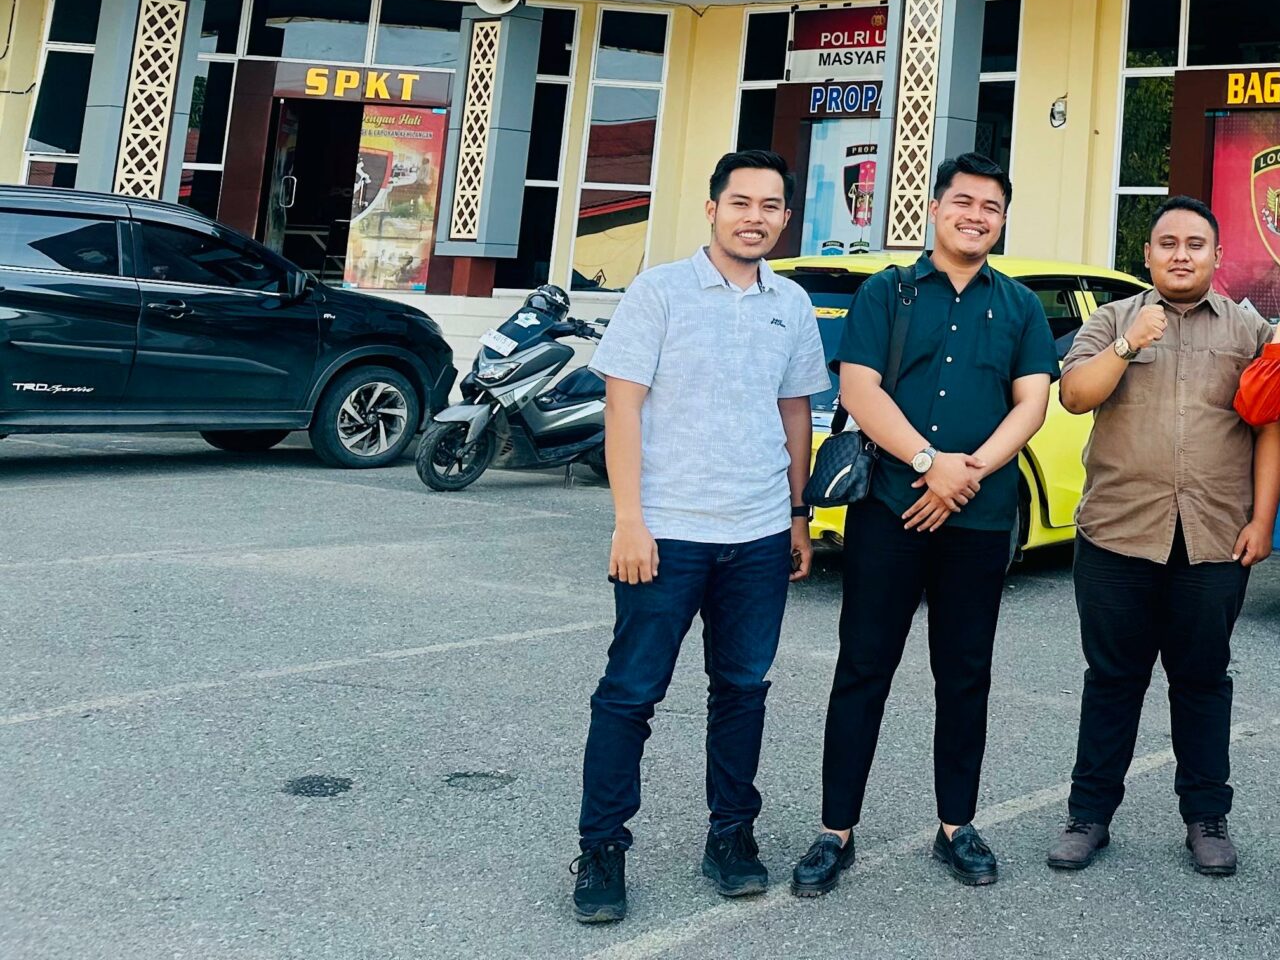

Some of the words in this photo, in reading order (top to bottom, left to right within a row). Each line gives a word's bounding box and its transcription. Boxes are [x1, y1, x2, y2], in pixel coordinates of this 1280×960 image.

[820, 30, 870, 47] POLRI
[818, 50, 885, 66] MASYAR
[305, 67, 420, 101] SPKT
[1227, 71, 1280, 105] BAG
[809, 84, 881, 114] PROP
[851, 144, 877, 154] PROP
[12, 382, 49, 392] TRD
